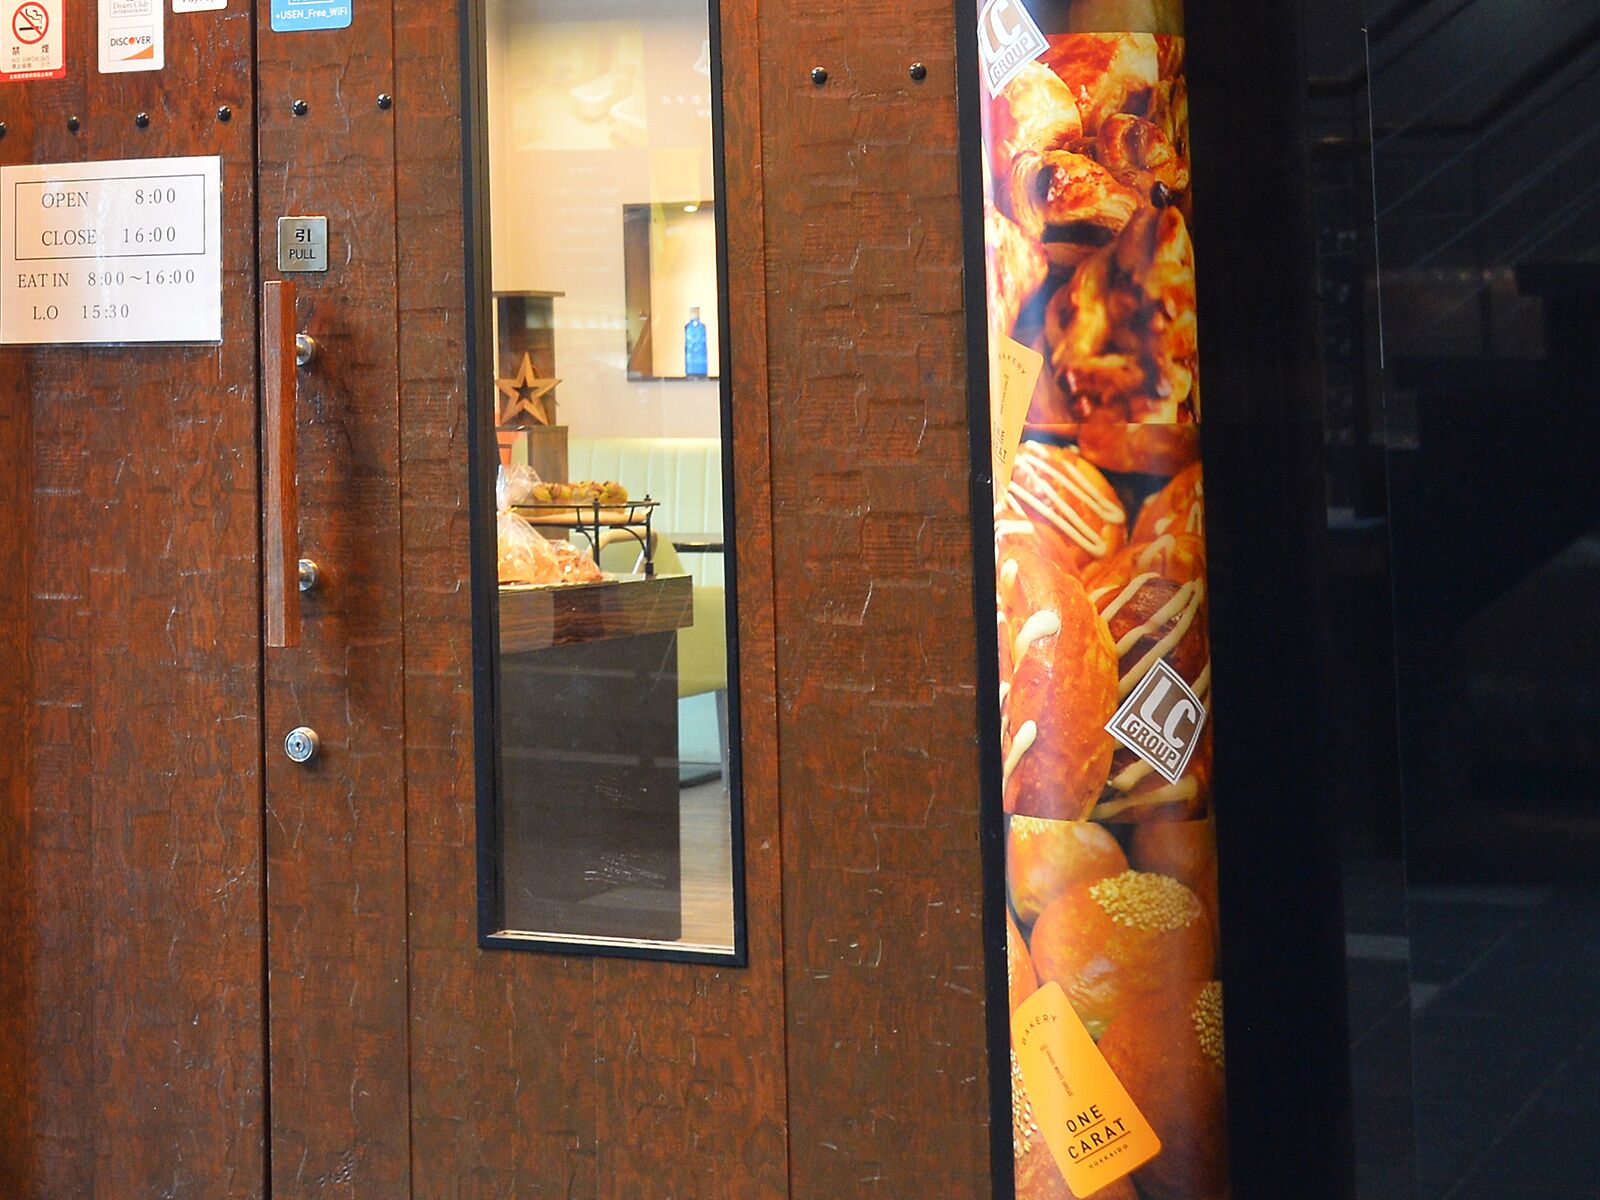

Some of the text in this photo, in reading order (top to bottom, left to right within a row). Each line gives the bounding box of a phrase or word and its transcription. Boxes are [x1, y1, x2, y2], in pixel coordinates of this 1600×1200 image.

[110, 35, 151, 46] DISCOVER
[993, 36, 1030, 80] GROUP
[41, 188, 176, 209] OPEN 8:00
[41, 226, 176, 247] CLOSE 16:00
[296, 229, 311, 243] 引
[289, 248, 316, 260] PULL
[18, 273, 48, 289] EAT
[53, 272, 69, 287] IN
[33, 304, 130, 320] L.O 15:30
[1140, 675, 1197, 749] LC
[1126, 719, 1177, 765] GROUP
[1021, 1013, 1058, 1046] BAKERY
[1066, 1104, 1104, 1133] ONE
[1067, 1117, 1126, 1160] CARAT
[1088, 1144, 1129, 1169] HOKKAIDO
